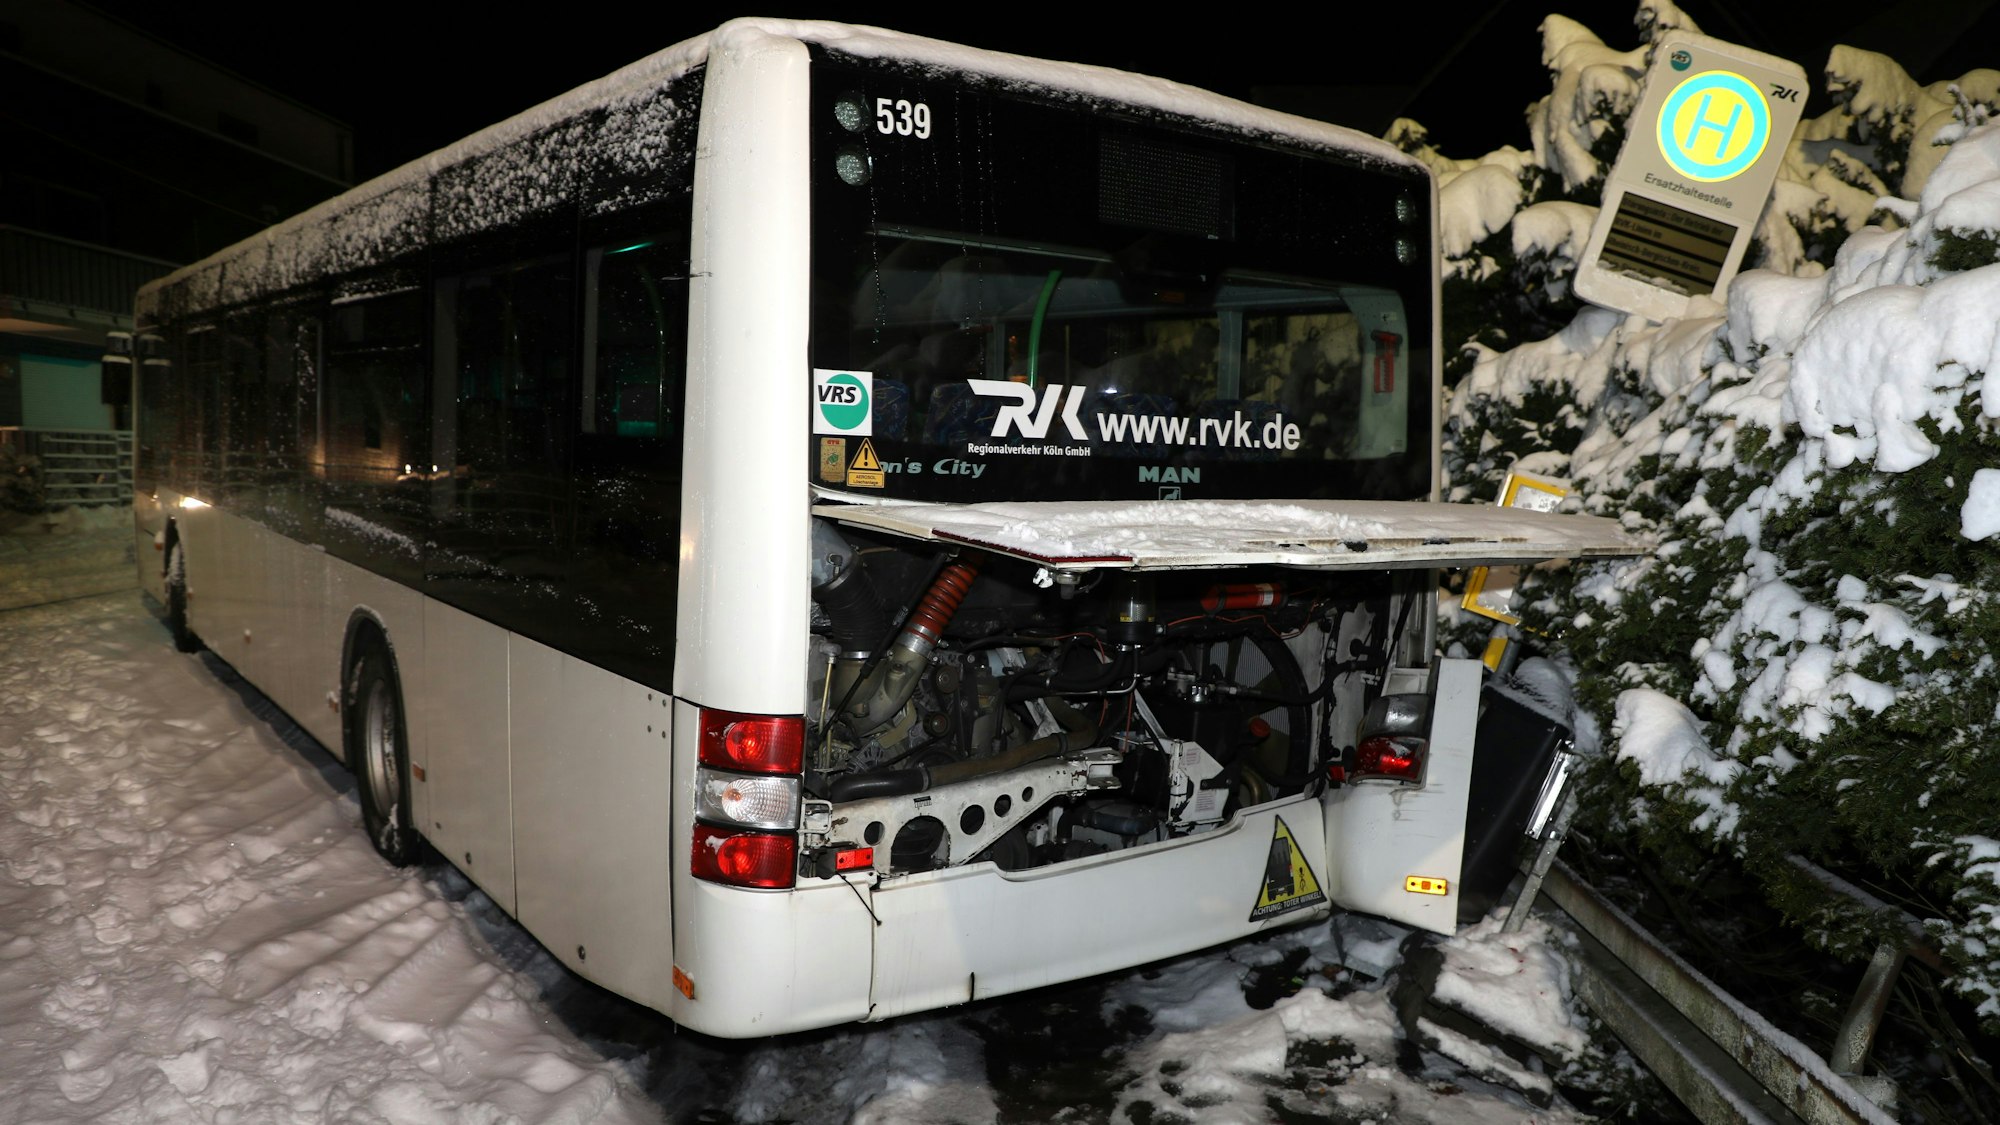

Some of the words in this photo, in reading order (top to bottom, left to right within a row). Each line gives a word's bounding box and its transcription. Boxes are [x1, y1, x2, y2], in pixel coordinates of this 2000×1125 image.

[1671, 51, 1688, 63] VRS
[1769, 82, 1799, 103] RVK
[876, 97, 931, 140] 539
[1684, 93, 1744, 160] H
[1644, 172, 1733, 209] Ersatzhaltestelle
[817, 384, 857, 404] VRS
[966, 378, 1089, 441] RVK
[1096, 410, 1300, 451] www.rvk.de
[967, 442, 1042, 456] Regionalverkehr
[1043, 445, 1064, 456] Köln
[1065, 446, 1091, 457] GmbH
[932, 458, 986, 479] City
[1138, 465, 1201, 484] MAN
[1252, 903, 1282, 917] ACHTUNG:
[1283, 898, 1300, 908] TOTER
[1300, 892, 1321, 903] WINKEL!
